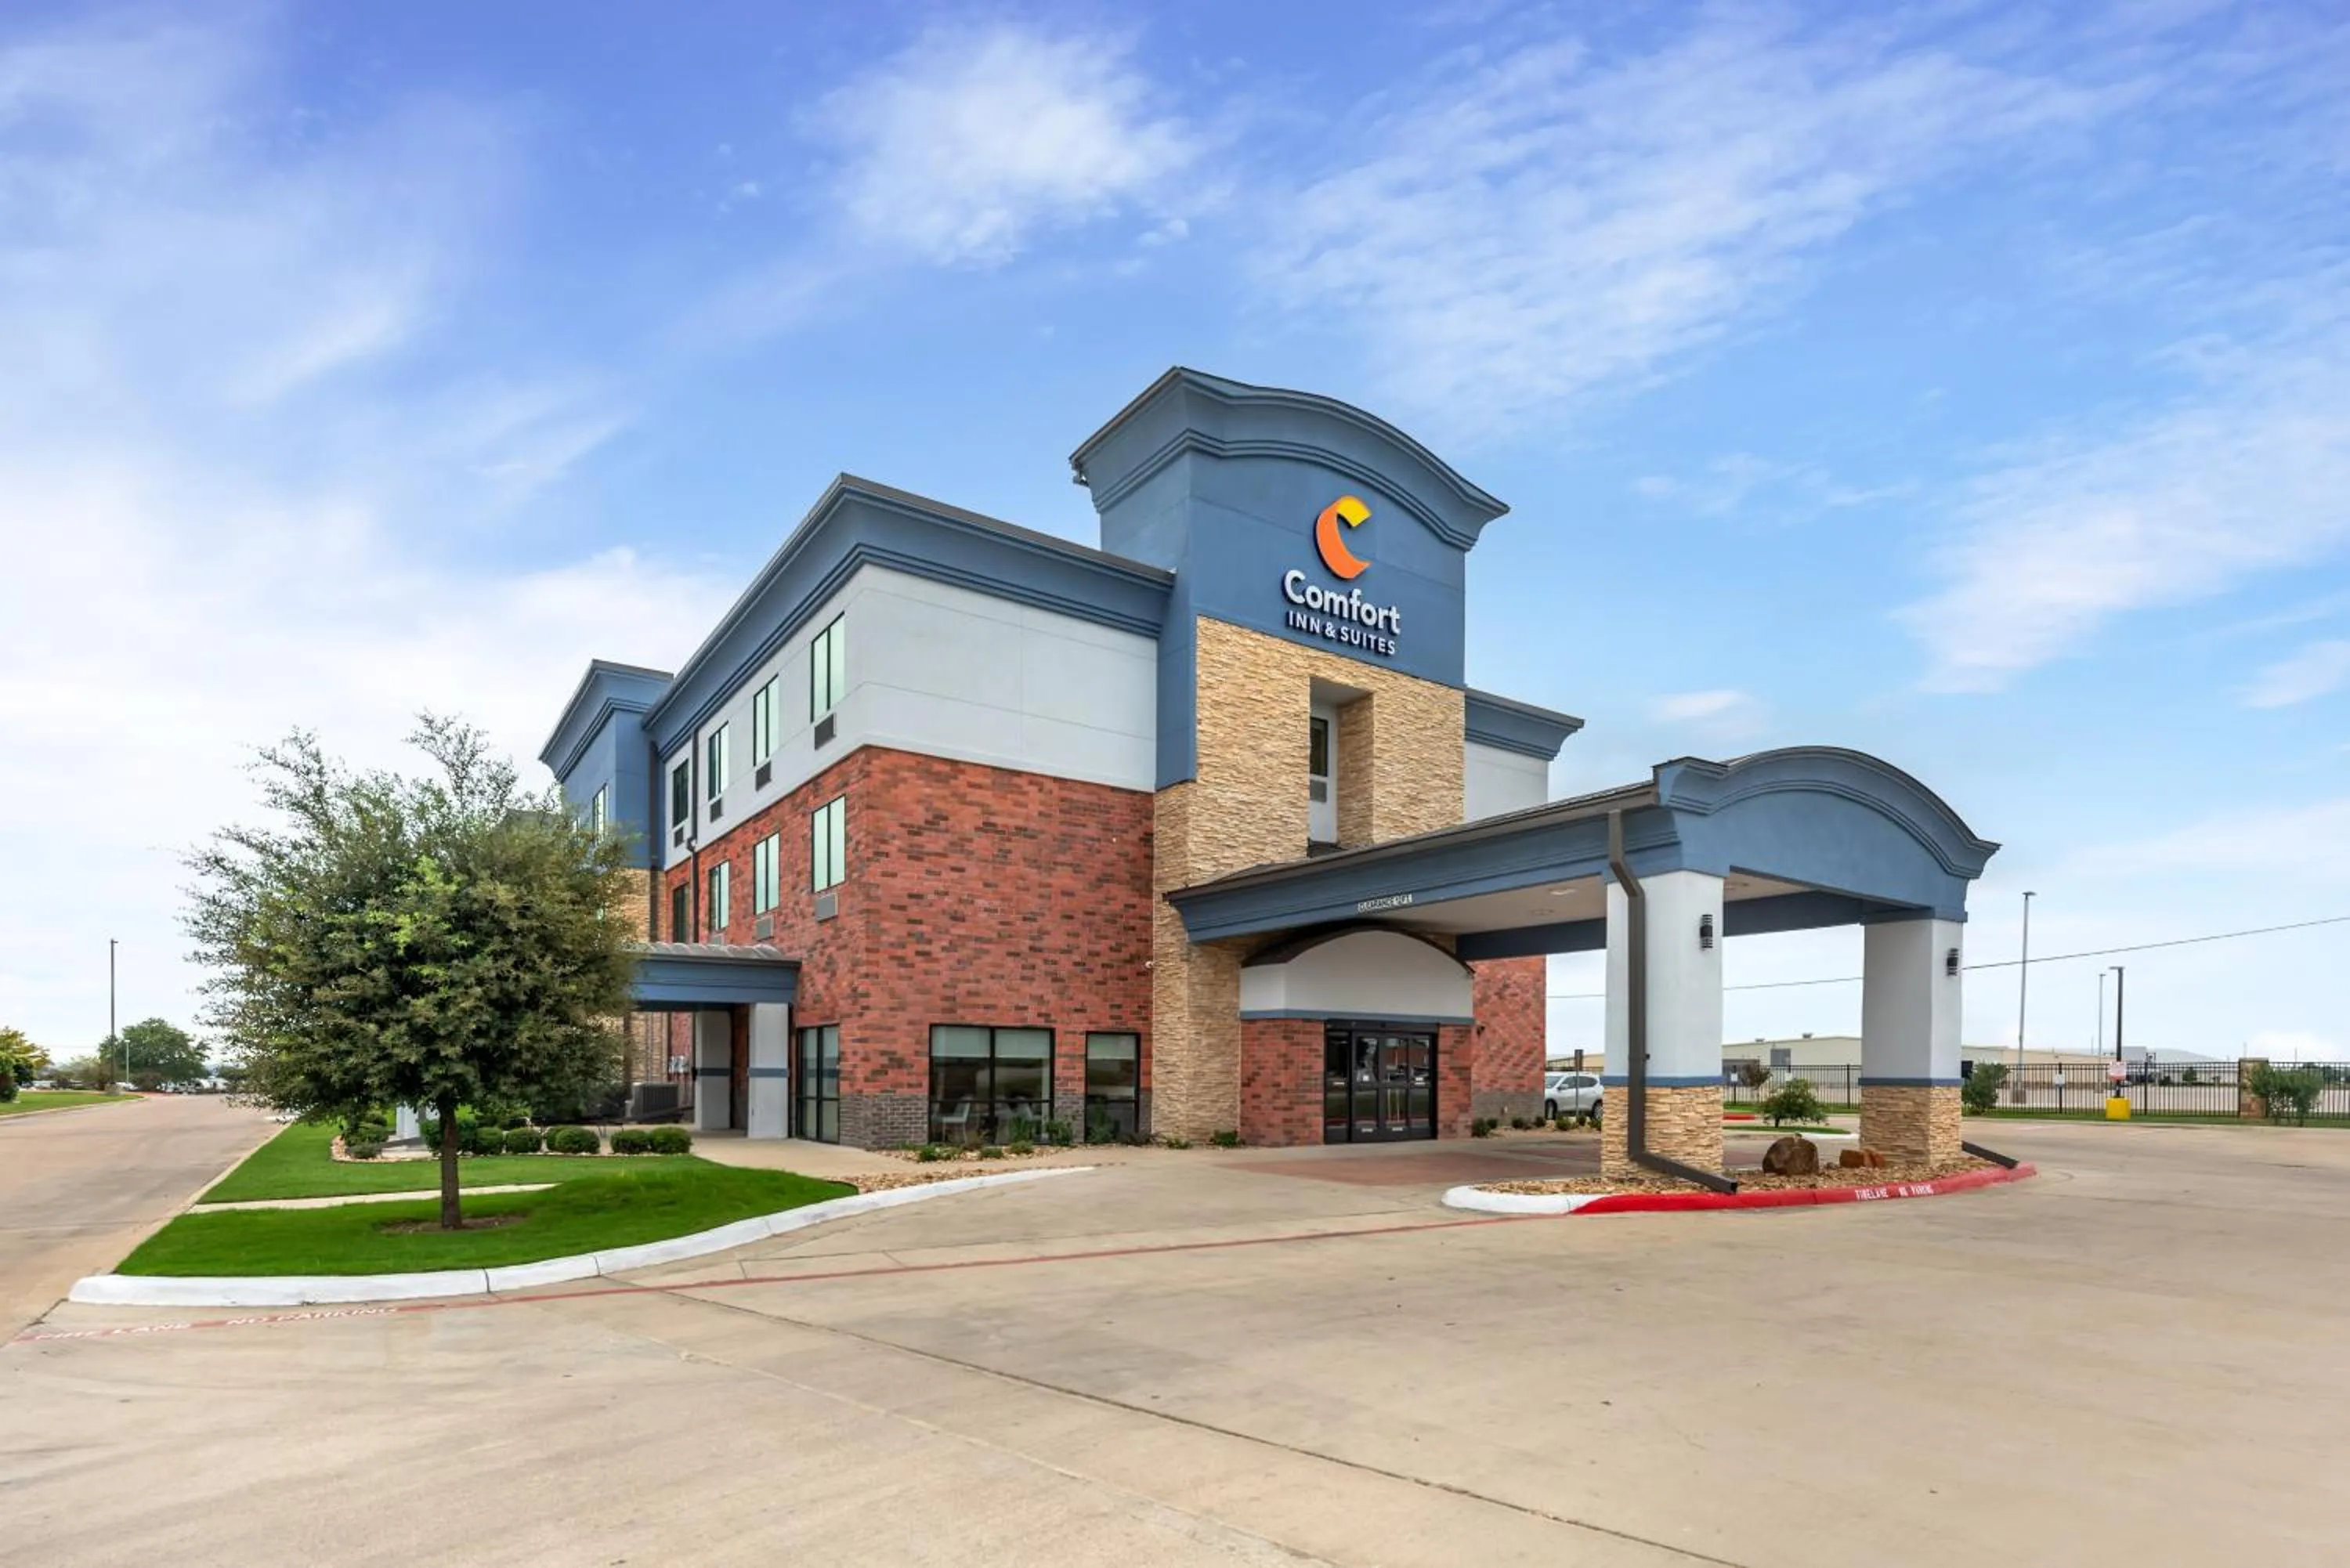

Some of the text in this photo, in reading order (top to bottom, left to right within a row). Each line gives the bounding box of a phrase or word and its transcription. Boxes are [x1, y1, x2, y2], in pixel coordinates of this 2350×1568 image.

[1284, 569, 1401, 634] Comfort
[1289, 610, 1396, 655] INN & SUITES
